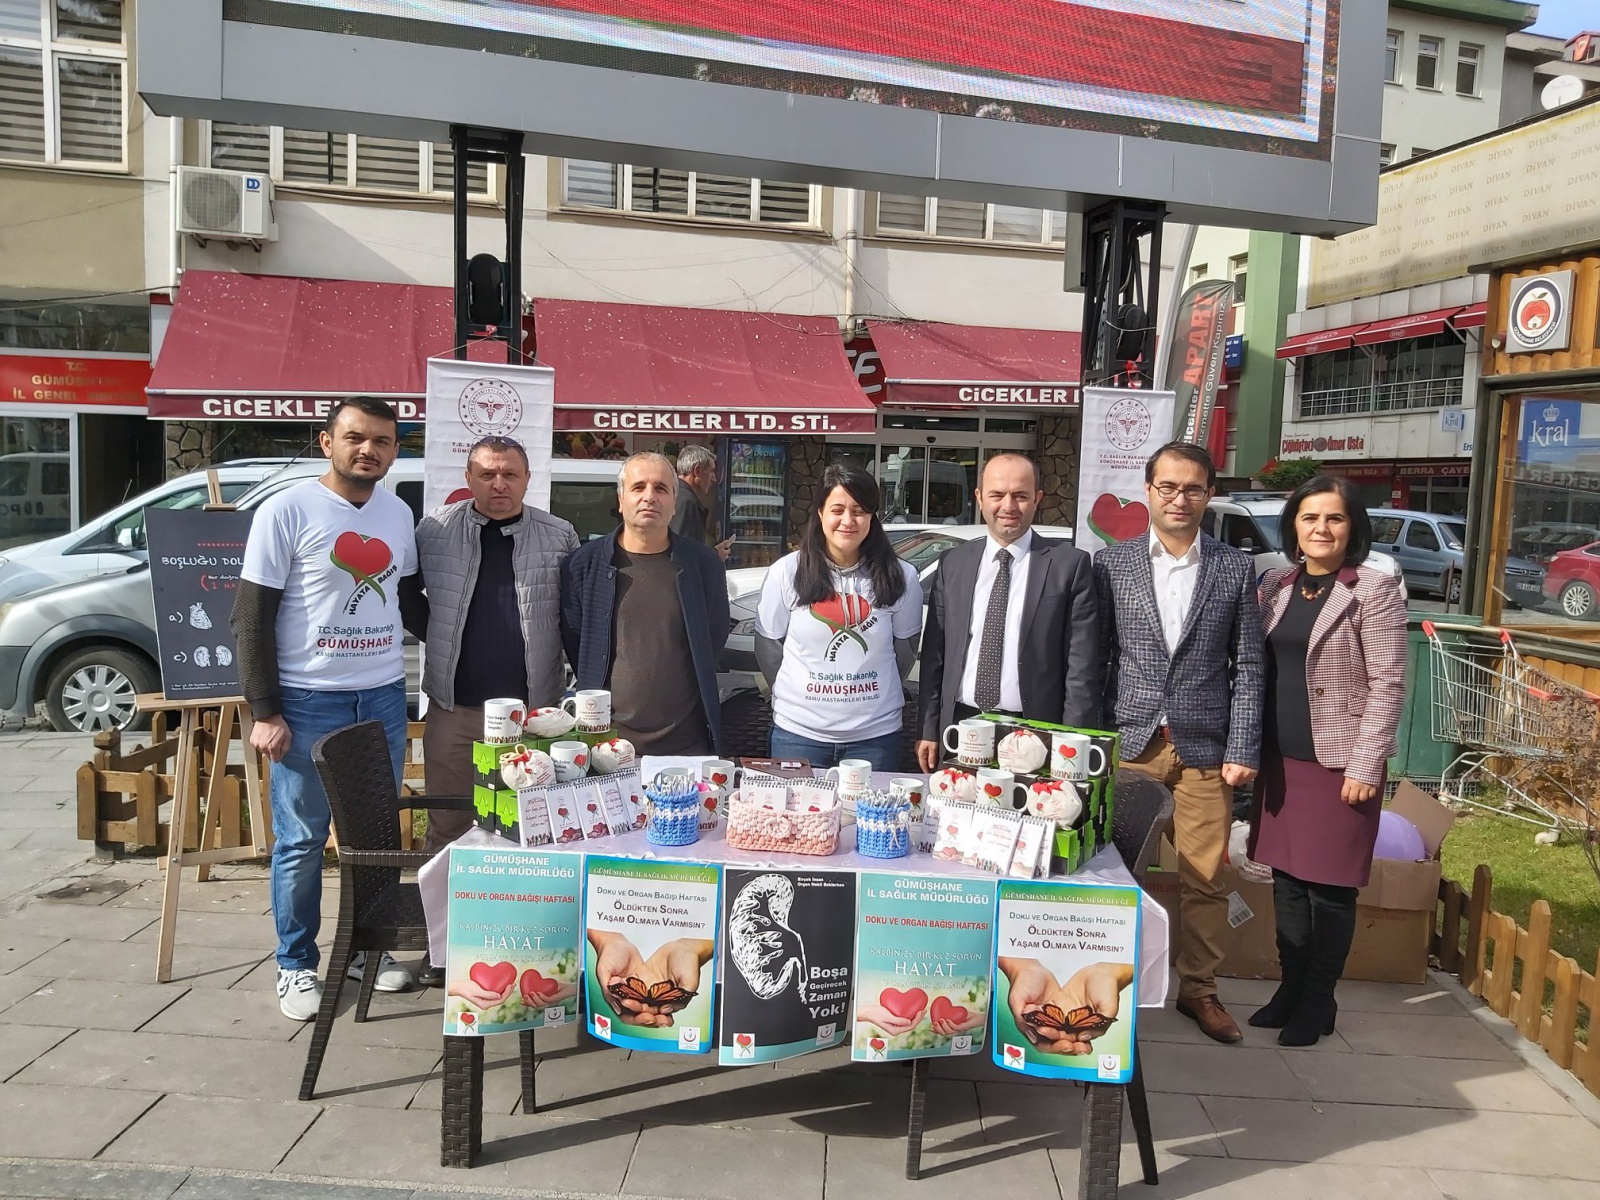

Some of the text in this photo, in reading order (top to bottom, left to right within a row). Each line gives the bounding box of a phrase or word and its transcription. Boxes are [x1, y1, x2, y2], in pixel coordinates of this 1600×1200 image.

[1205, 352, 1217, 392] Güven
[13, 387, 26, 399] İL
[729, 414, 784, 430] LTD.
[1528, 418, 1569, 448] kral
[161, 555, 217, 570] BOŞLUĞU
[348, 564, 398, 615] HAYATA BAĞIŞ
[334, 626, 363, 638] Sağlık
[317, 635, 394, 651] GÜMÜŞHANE
[829, 634, 850, 662] HAYATA
[818, 672, 844, 683] Sağlık
[846, 670, 878, 681] Bakanlığı
[806, 682, 879, 697] GÜMÜŞHANE
[483, 853, 550, 866] GÜMÜŞHANE
[456, 863, 575, 878] İL SAĞLIK MÜDÜRLÜĞÜ
[894, 879, 963, 894] GÜMÜŞHANE
[455, 891, 575, 904] DOKU VE ORGAN BAĞIŞI HAFTASI
[867, 888, 989, 905] İL SAĞLIK MÜDÜRLÜĞÜ
[614, 899, 689, 916] ÖLDÜKTEN SONRA
[596, 912, 625, 924] YAŞAM
[627, 914, 661, 926] OLMAYA
[866, 916, 988, 931] DOKU VE ORGAN BAĞIŞI HAFTASI
[1028, 924, 1107, 939] ÖLDÜKTEN SONRA
[484, 934, 545, 952] HAYAT
[1009, 937, 1040, 950] YAŞAM
[1042, 939, 1077, 951] OLMAYA
[810, 966, 848, 980] Boşa
[894, 960, 957, 978] HAYAT
[810, 980, 847, 990] Geçirecek
[809, 990, 847, 1002] Zaman
[808, 1002, 846, 1020] Yok!
